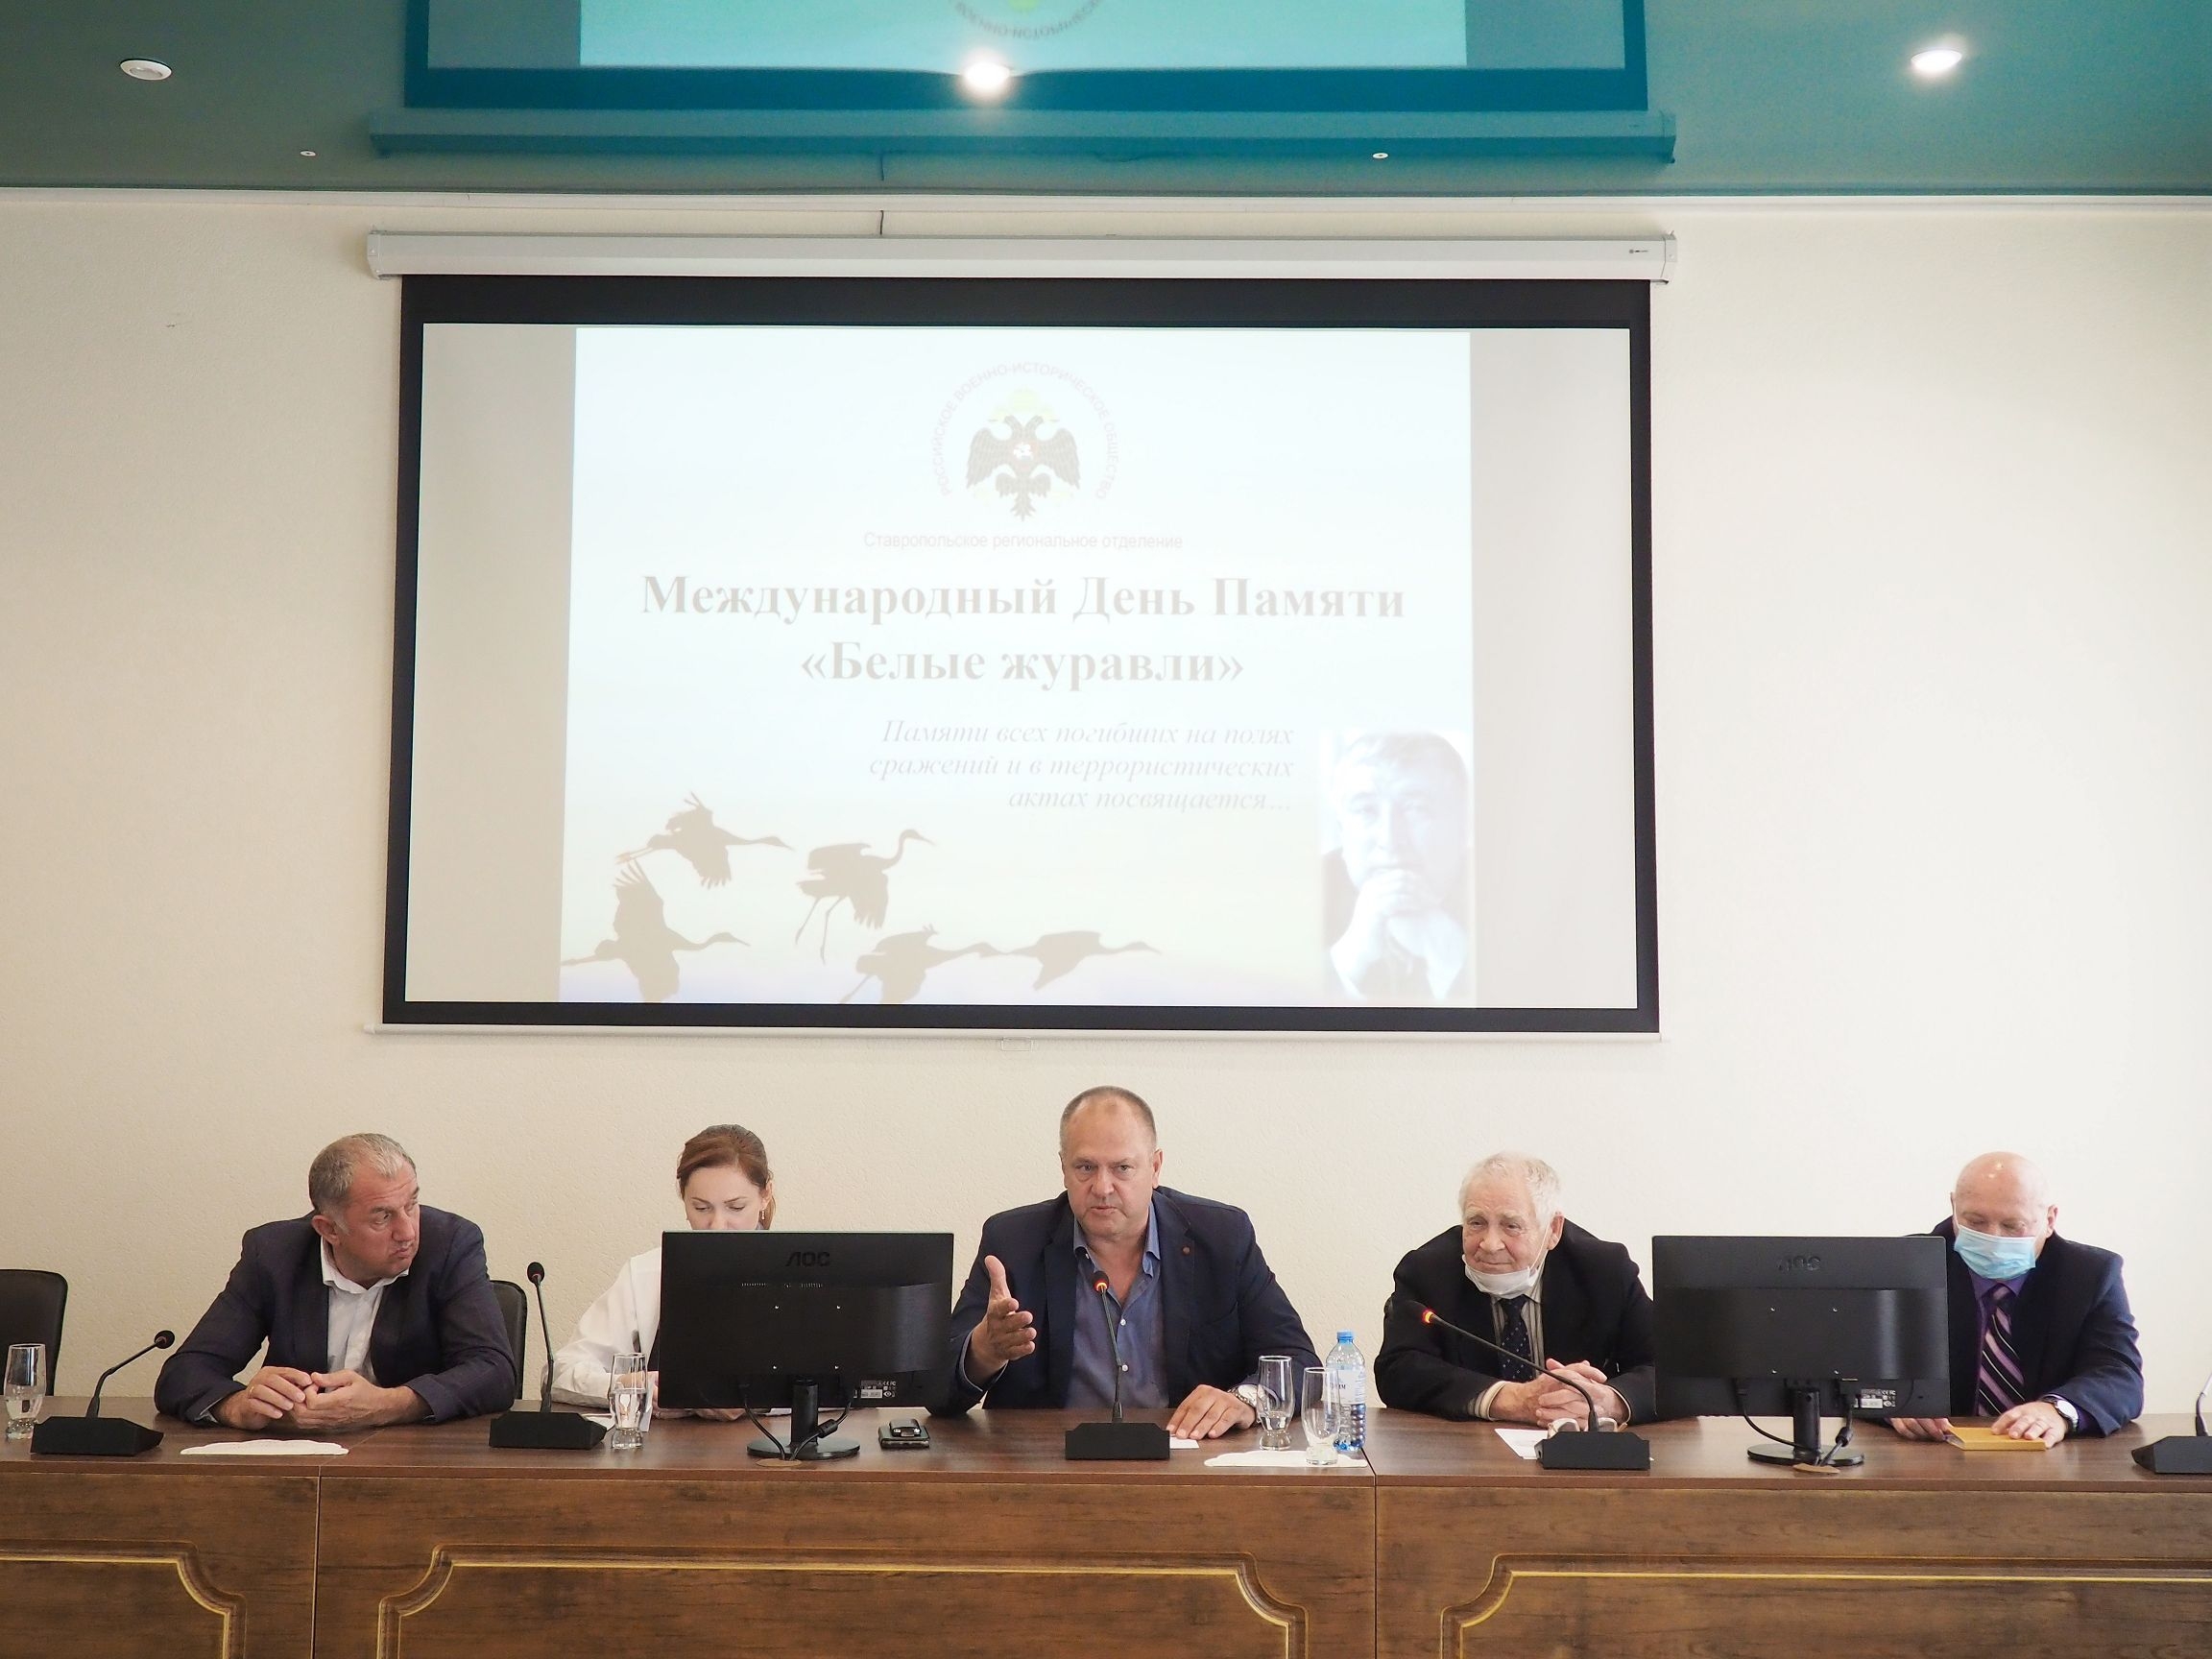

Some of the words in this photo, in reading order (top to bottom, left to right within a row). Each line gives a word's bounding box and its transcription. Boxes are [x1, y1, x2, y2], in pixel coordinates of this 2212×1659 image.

[863, 532, 988, 549] Ставропольское
[993, 534, 1097, 550] региональное
[1102, 535, 1184, 550] отделение
[641, 575, 1058, 624] Международный
[1072, 576, 1194, 623] День
[1214, 577, 1406, 618] Памяти
[801, 641, 986, 681] «Белые
[1000, 653, 1243, 691] журавли»
[882, 719, 989, 743] Памяти
[996, 726, 1047, 742] всех
[1056, 722, 1177, 743] погибших
[1186, 728, 1215, 743] на
[1224, 728, 1295, 745] полях
[870, 756, 998, 781] сражений
[1006, 760, 1022, 775] и
[1029, 758, 1043, 776] в
[1050, 759, 1295, 781] террористических
[1008, 792, 1088, 807] актах
